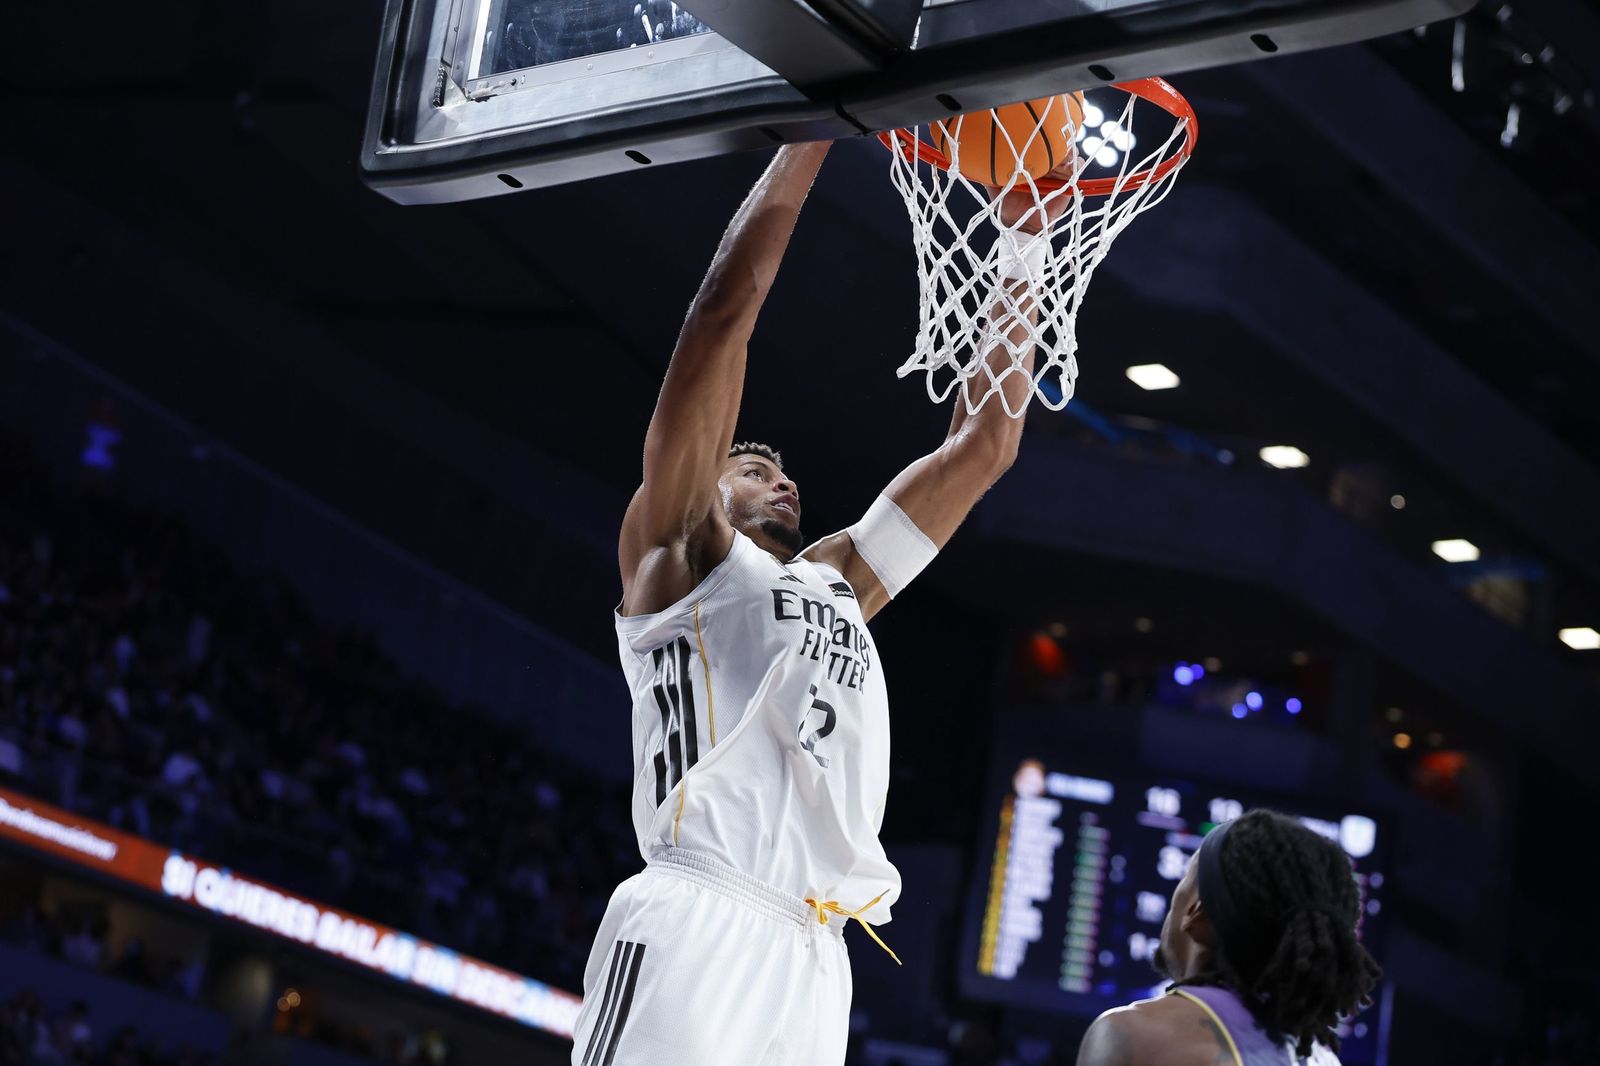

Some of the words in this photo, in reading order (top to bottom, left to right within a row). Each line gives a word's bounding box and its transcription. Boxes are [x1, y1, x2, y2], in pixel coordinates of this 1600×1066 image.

[770, 588, 871, 671] Emates
[799, 628, 831, 664] FLY
[826, 651, 865, 695] TTER
